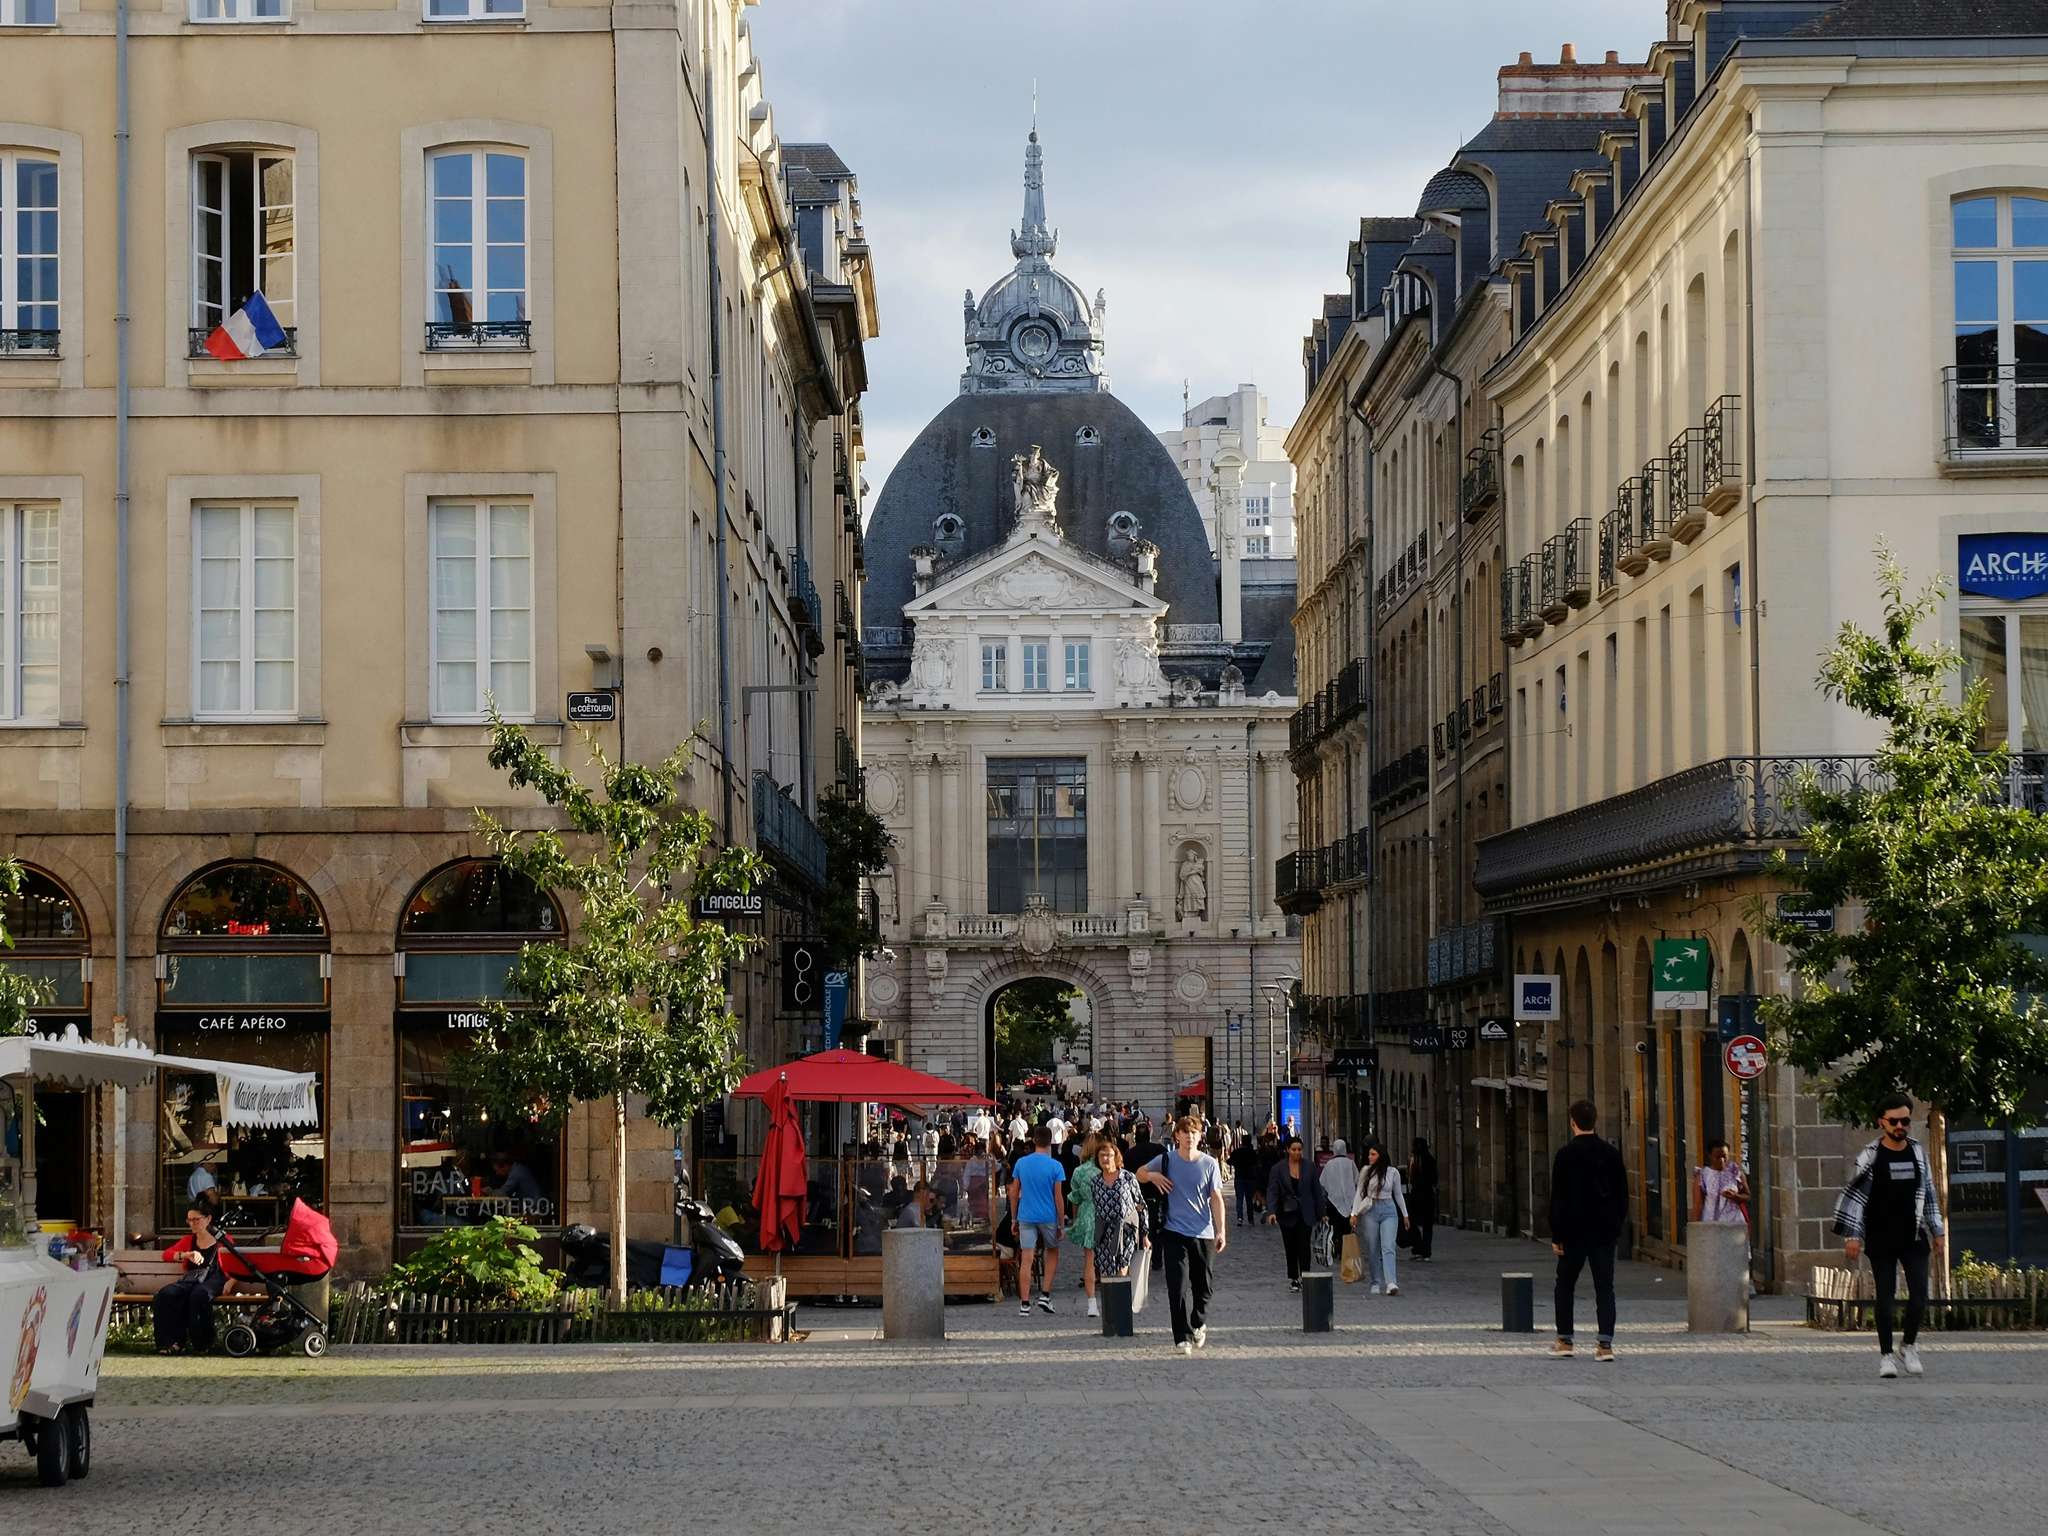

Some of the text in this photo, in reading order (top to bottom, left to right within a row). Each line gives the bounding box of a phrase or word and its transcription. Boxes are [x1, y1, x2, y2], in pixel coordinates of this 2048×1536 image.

[199, 1015, 286, 1030] CAFÉ APÉRO
[1451, 1030, 1467, 1039] RO
[1451, 1039, 1467, 1048] XY
[413, 1171, 465, 1195] BAR
